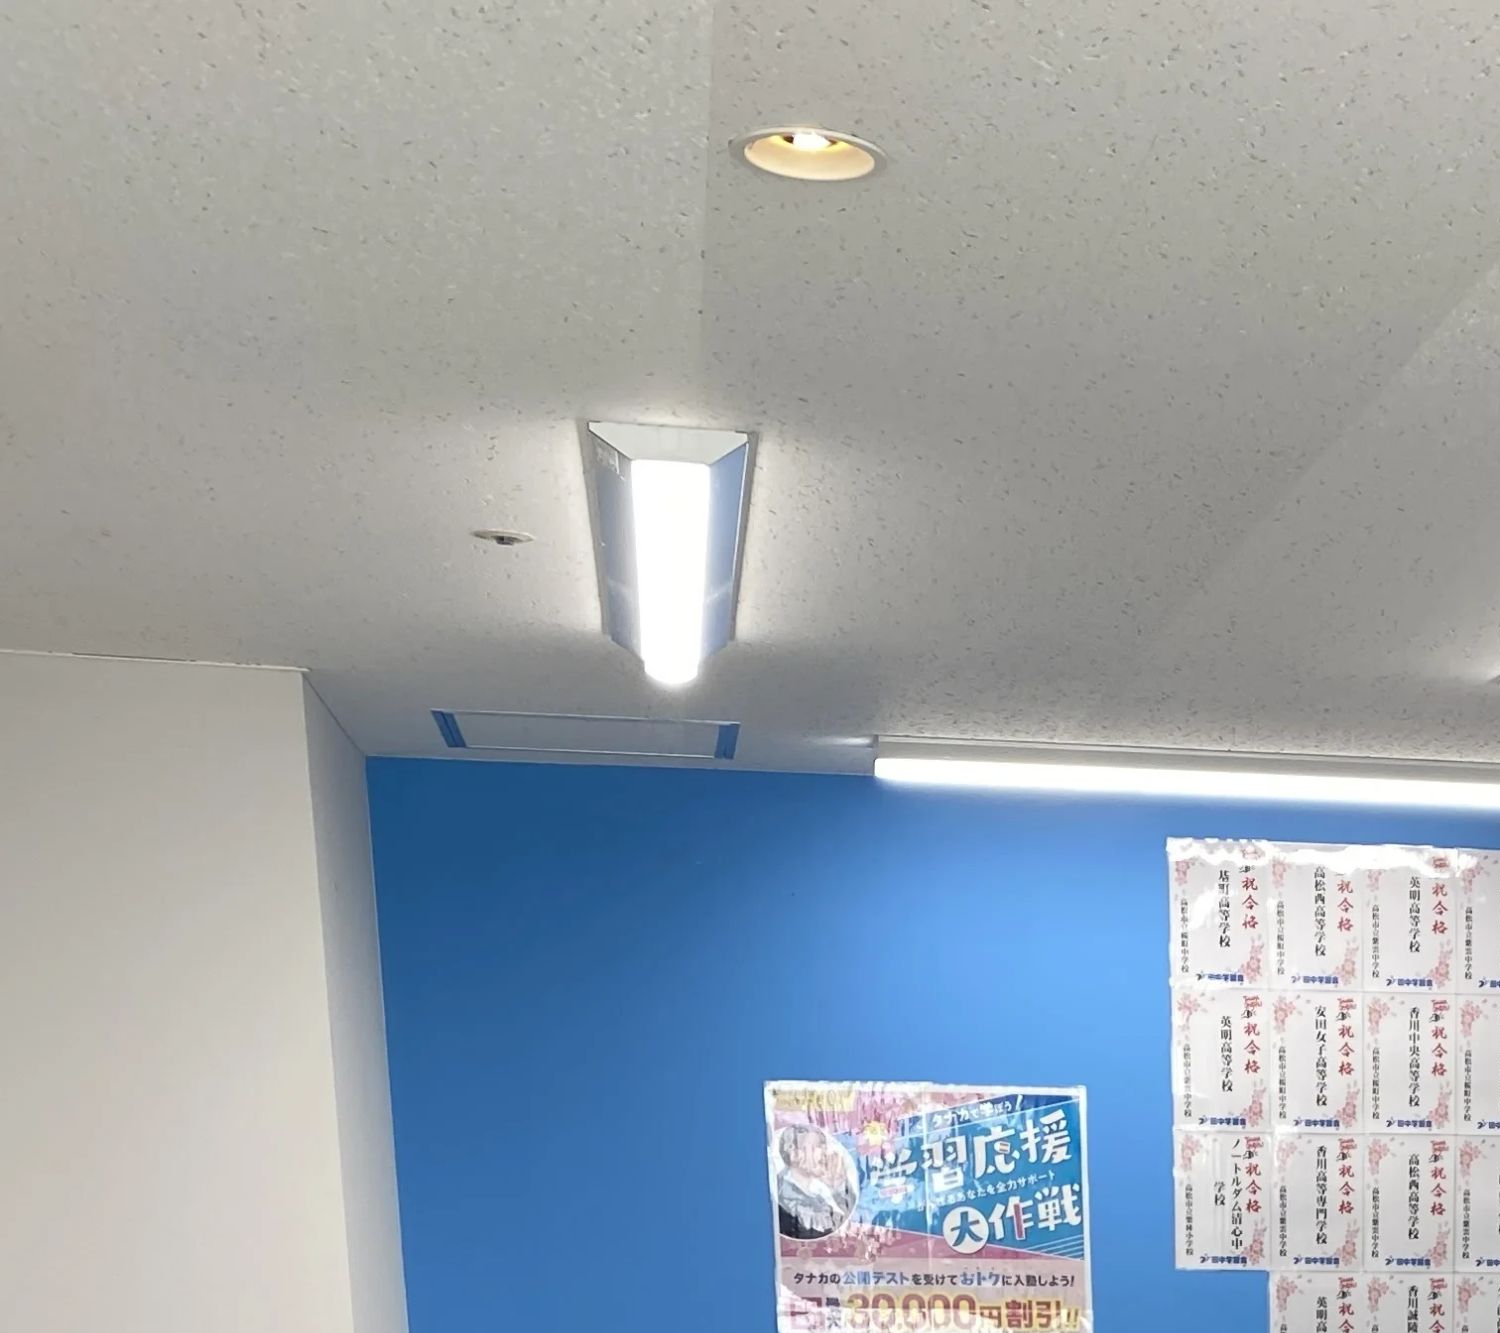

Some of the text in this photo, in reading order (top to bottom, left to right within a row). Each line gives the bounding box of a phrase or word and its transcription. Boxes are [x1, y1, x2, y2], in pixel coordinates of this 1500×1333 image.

[1314, 867, 1325, 956] 高松西高等学校
[1410, 877, 1420, 952] 英明高等学校
[1432, 883, 1448, 934] 祝合格
[1221, 1016, 1232, 1092] 英明高等学校
[1244, 1023, 1260, 1073] 祝合格
[1316, 1006, 1327, 1106] 安田女子高等学校
[1339, 1025, 1354, 1075] 祝合格
[1409, 1007, 1420, 1107] 香川中央高等学校
[1432, 1026, 1447, 1076] 祝合格
[948, 1183, 1081, 1250] 大作戦
[1214, 1182, 1225, 1206] 学校
[1231, 1138, 1243, 1249] ノートルダム清心中
[1246, 1163, 1261, 1213] 祝合格
[1316, 1146, 1327, 1244] 香川高等専門学校
[1339, 1165, 1354, 1214] 祝合格
[1409, 1154, 1419, 1239] 高松西高等学校
[1431, 1167, 1446, 1215] 祝合格
